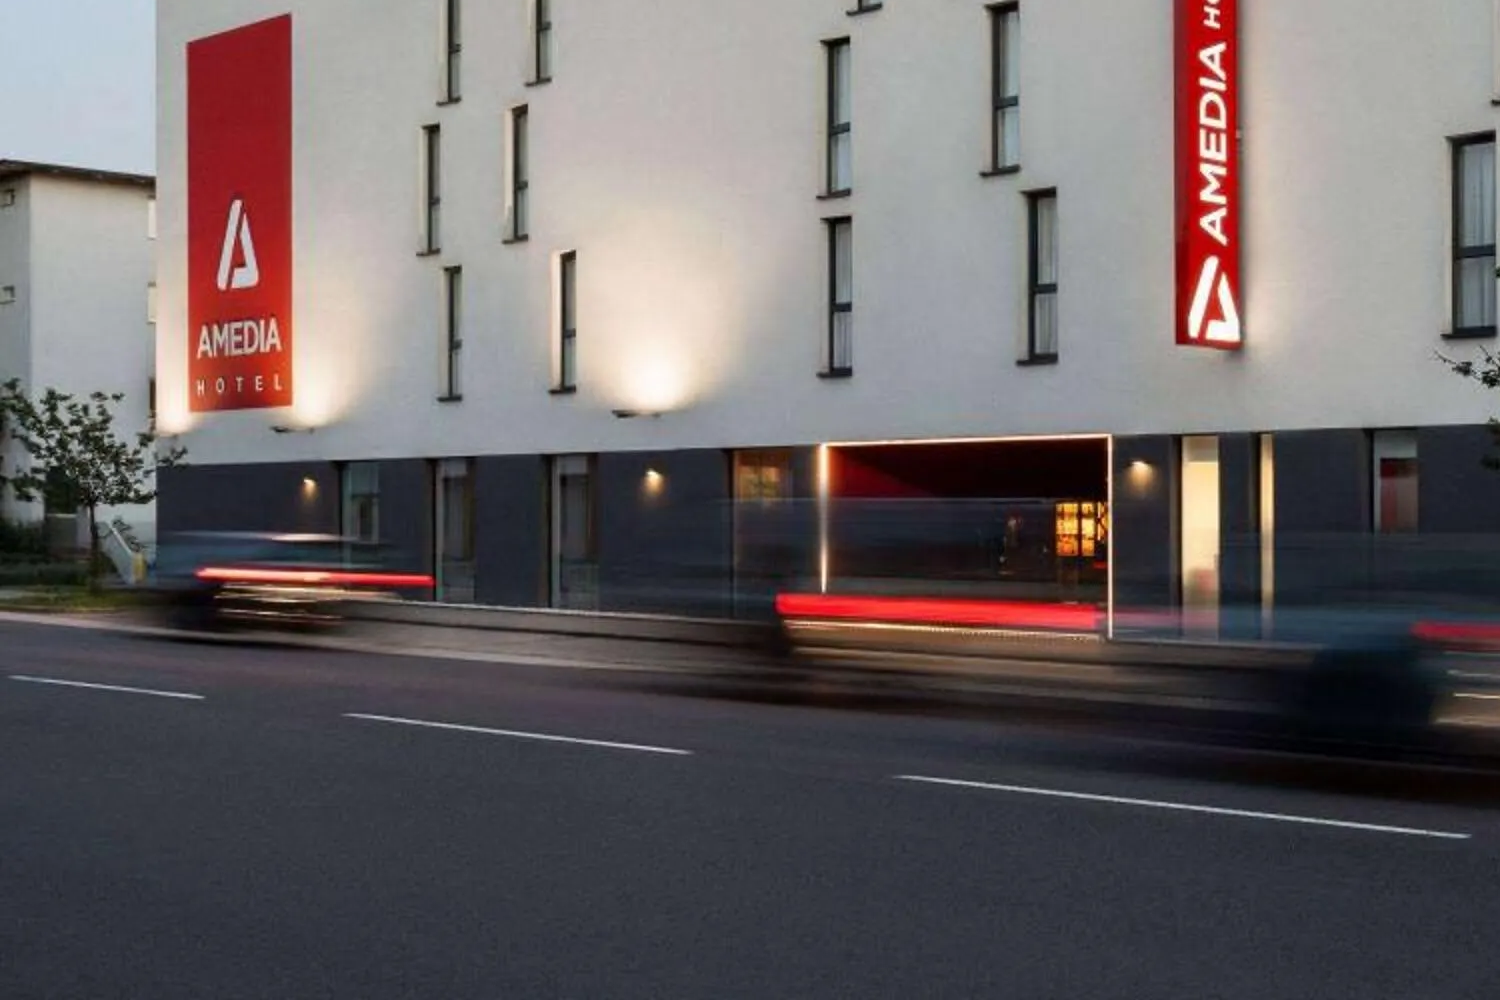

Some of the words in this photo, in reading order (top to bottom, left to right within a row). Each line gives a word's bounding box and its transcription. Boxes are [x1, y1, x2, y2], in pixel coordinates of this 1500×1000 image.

[1199, 41, 1228, 246] AMEDIA
[197, 317, 282, 359] AMEDIA
[197, 374, 283, 395] HOTEL
